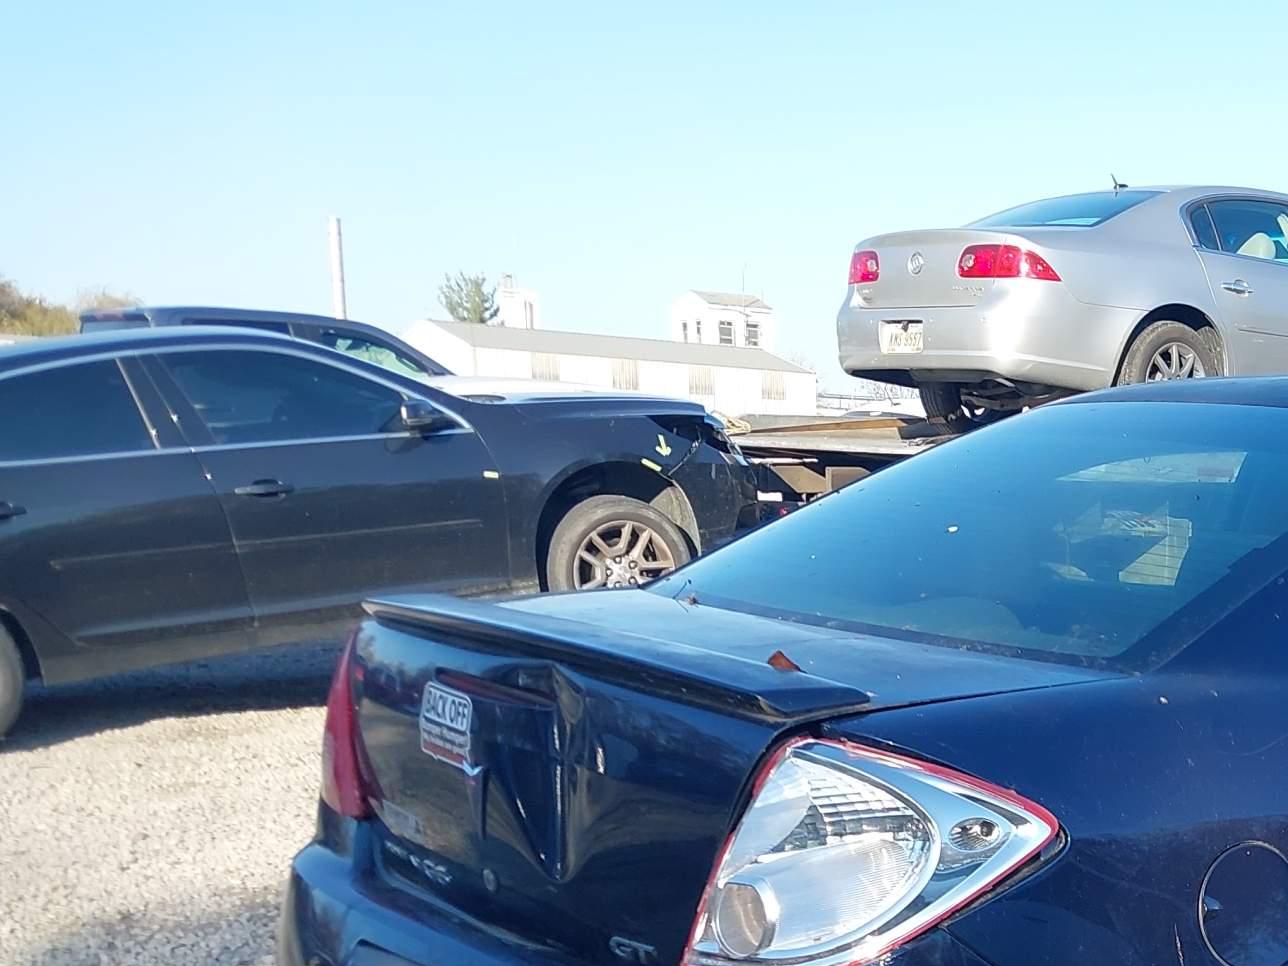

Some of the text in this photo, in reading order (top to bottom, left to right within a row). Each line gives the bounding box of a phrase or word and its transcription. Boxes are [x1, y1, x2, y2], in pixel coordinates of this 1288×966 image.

[425, 688, 468, 728] BACK OFF
[609, 936, 657, 965] GT
